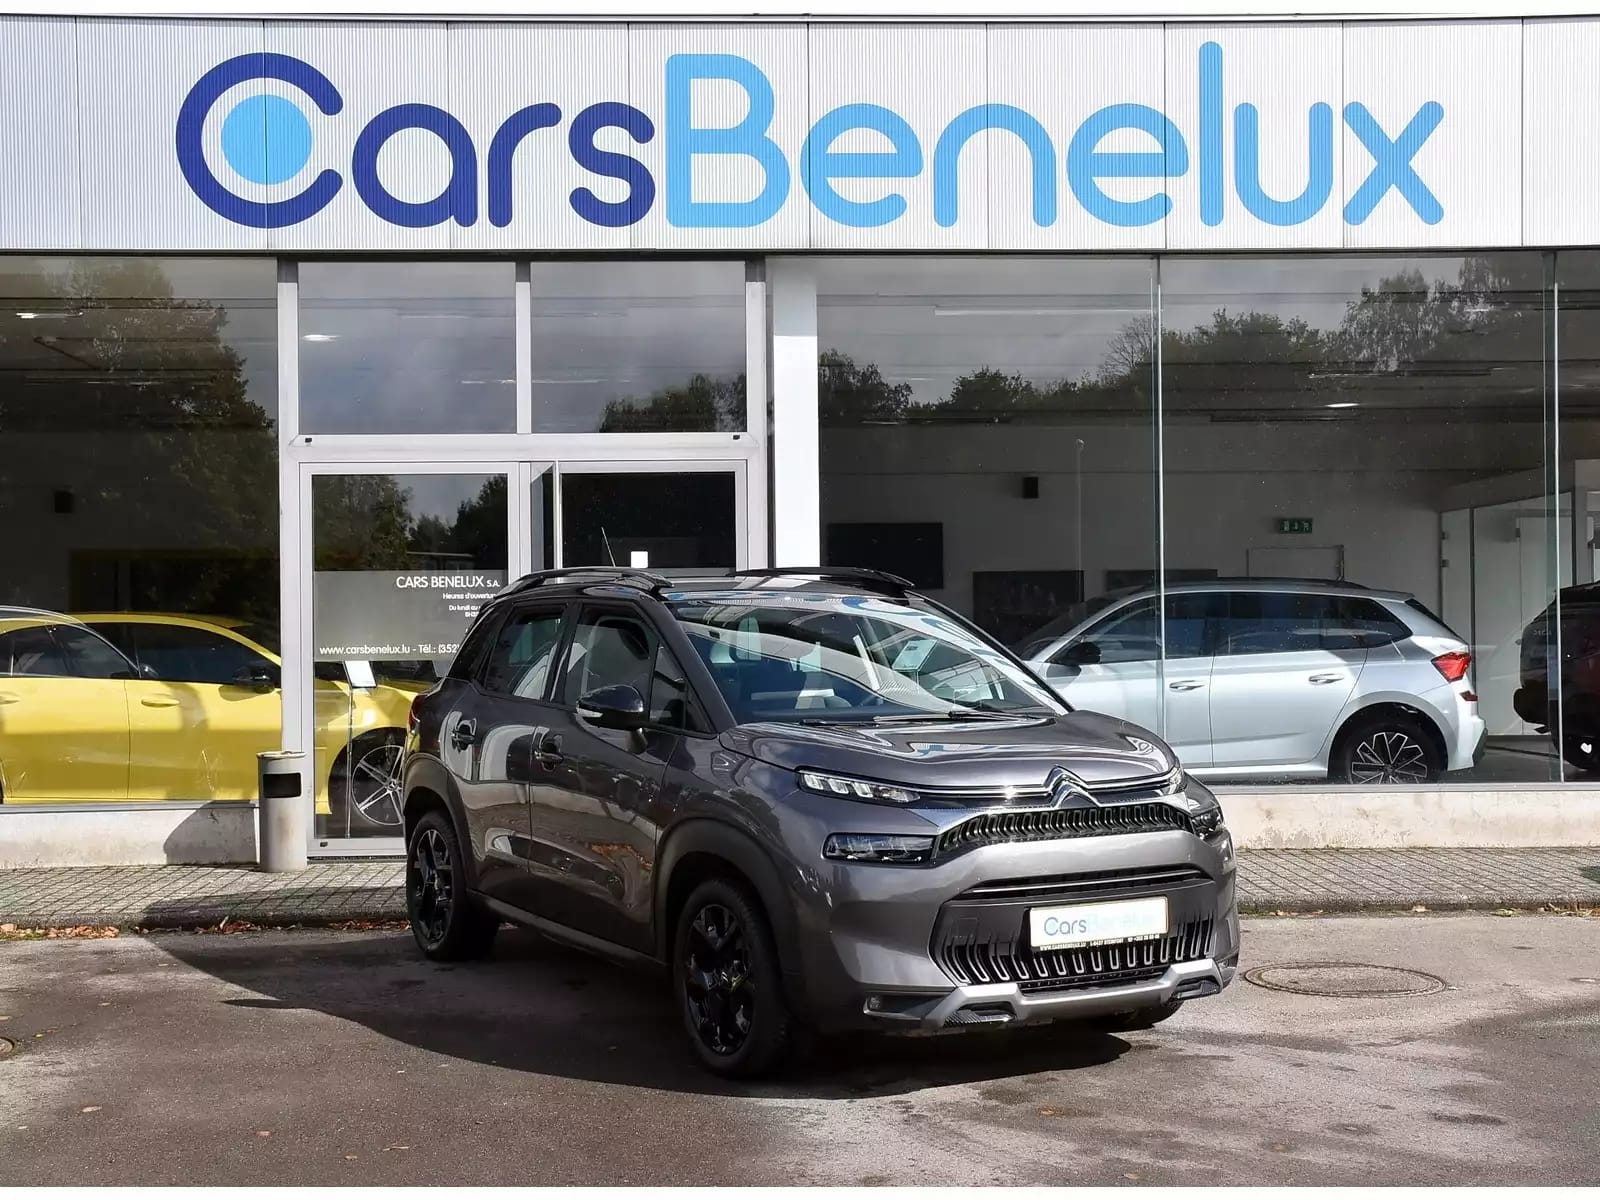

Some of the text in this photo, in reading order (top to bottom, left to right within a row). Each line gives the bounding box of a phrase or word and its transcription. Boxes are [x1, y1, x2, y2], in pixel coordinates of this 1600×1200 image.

[176, 41, 1444, 228] CarsBenelux
[396, 576, 429, 588] CARS
[431, 575, 484, 588] BENELUX
[319, 643, 410, 655] www.carsbenelux.lu
